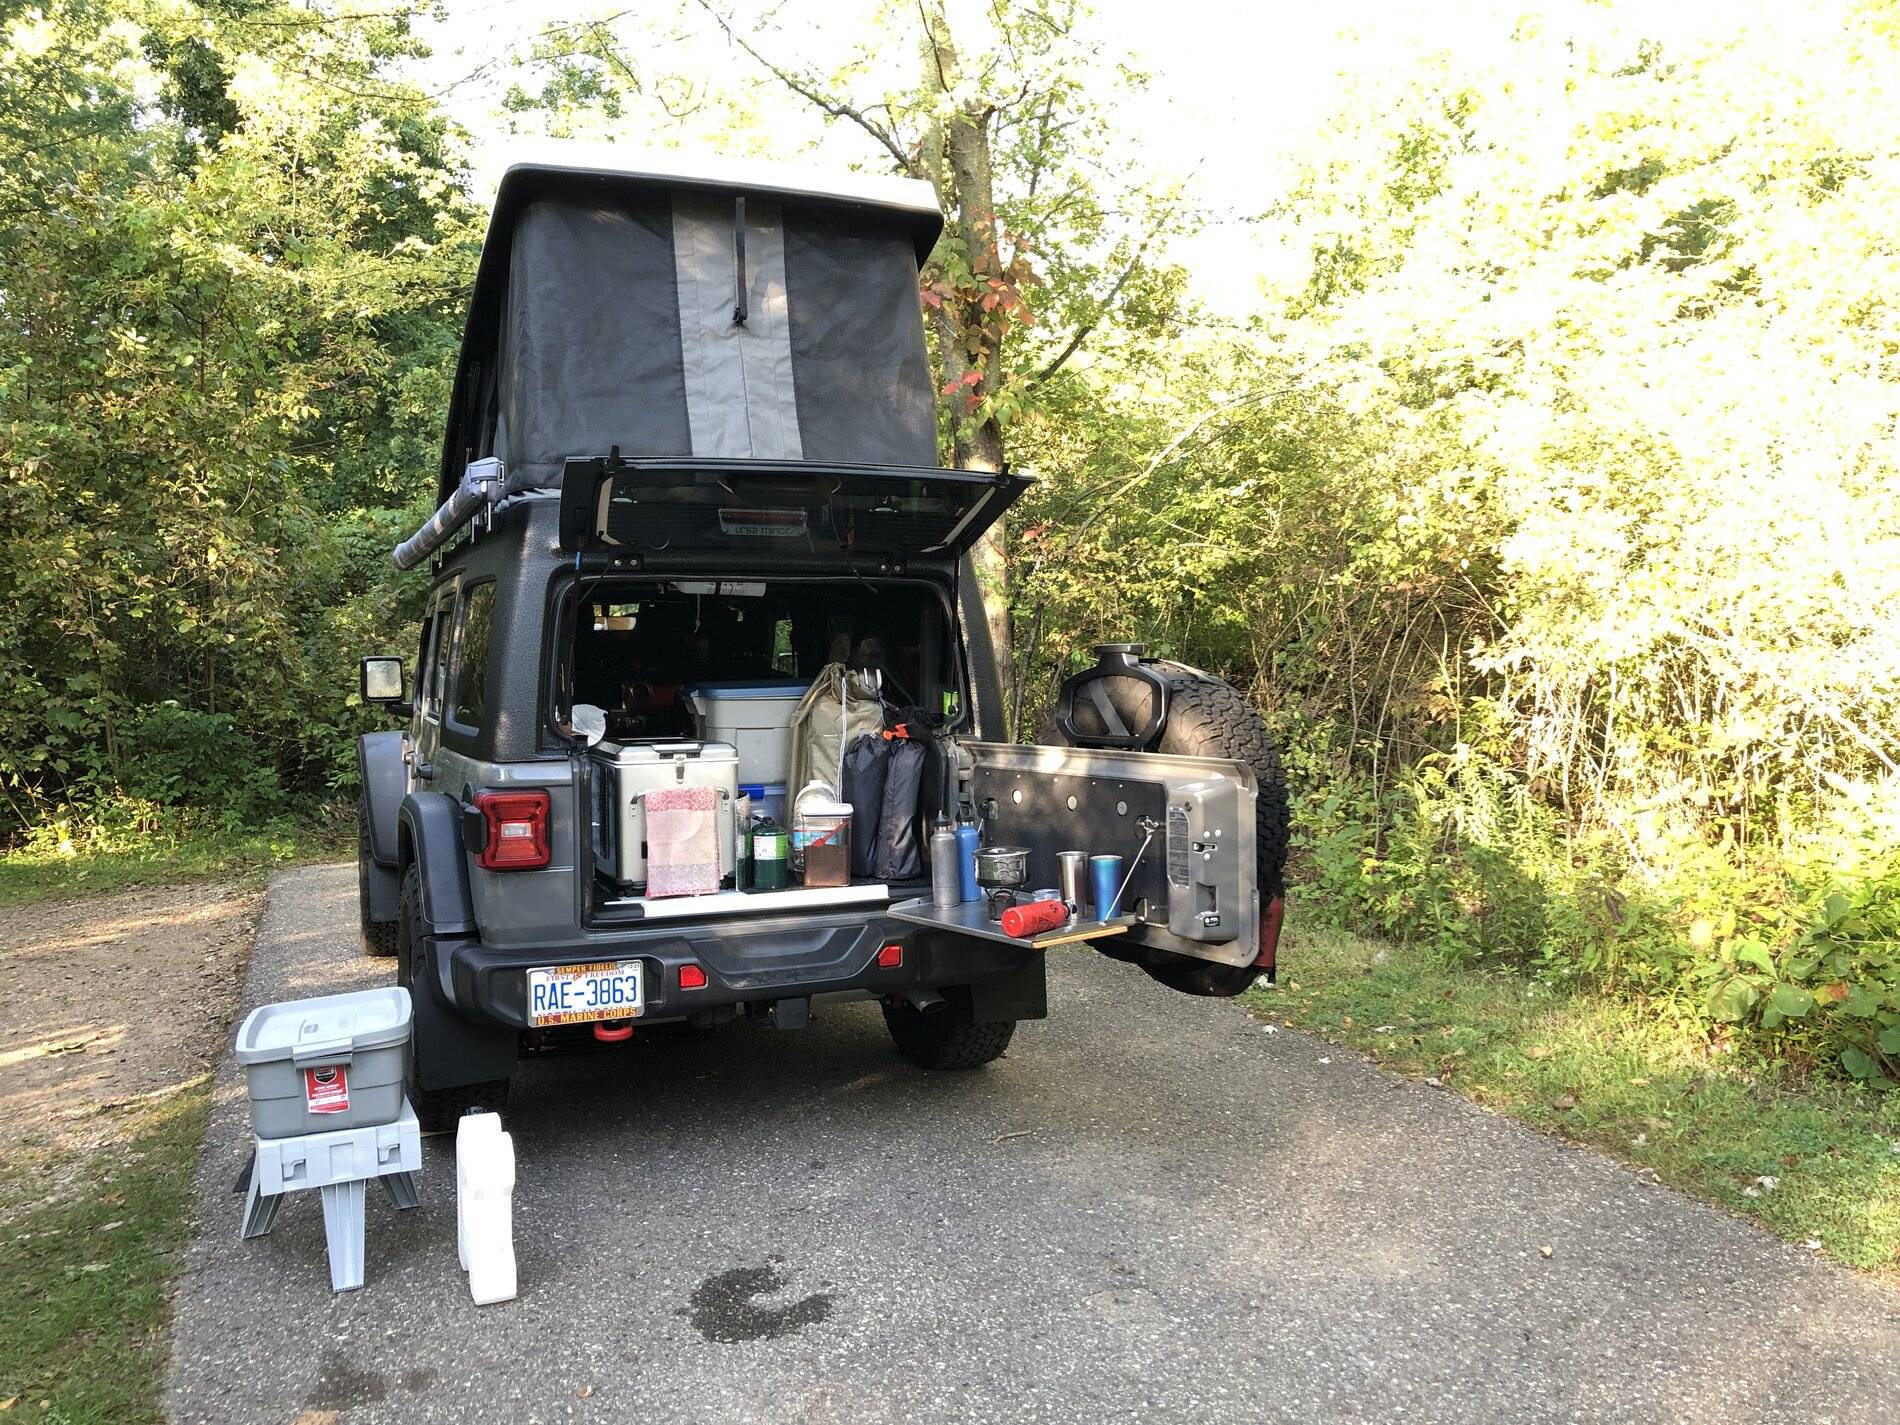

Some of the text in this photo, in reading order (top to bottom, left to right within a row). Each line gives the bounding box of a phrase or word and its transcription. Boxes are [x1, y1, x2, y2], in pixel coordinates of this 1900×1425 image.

[534, 975, 637, 1011] RAE-3863
[560, 1011, 600, 1022] MARINE
[603, 1007, 637, 1018] CORPS
